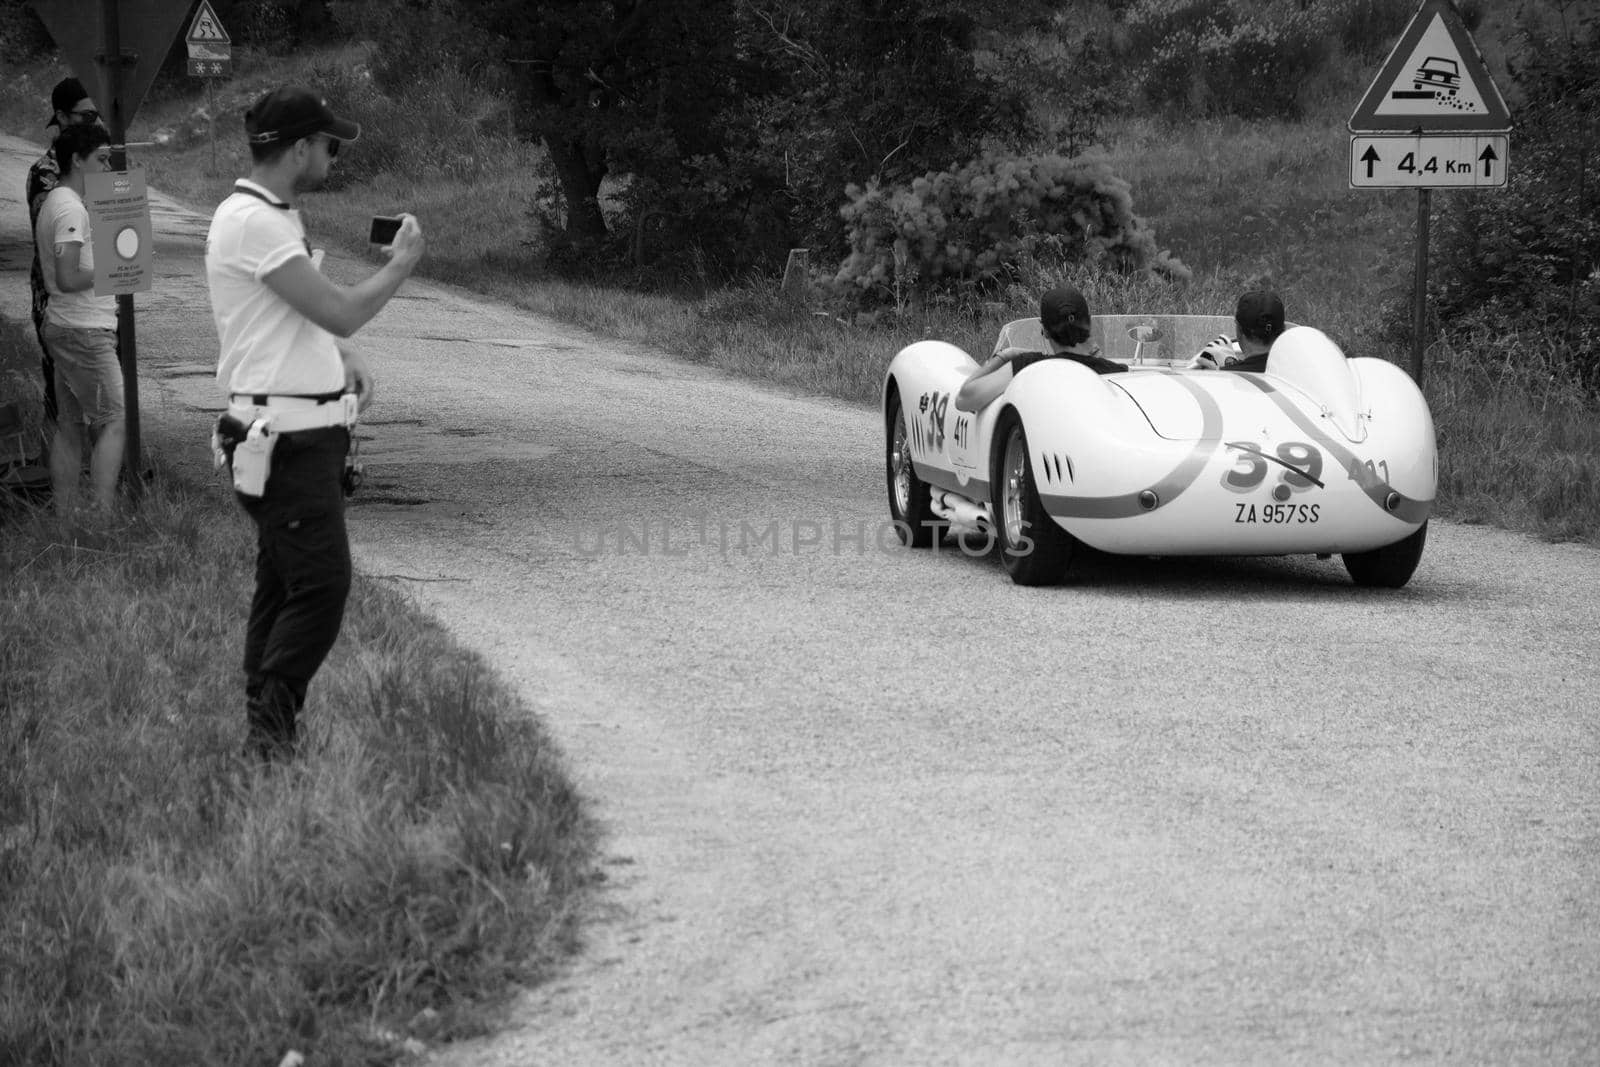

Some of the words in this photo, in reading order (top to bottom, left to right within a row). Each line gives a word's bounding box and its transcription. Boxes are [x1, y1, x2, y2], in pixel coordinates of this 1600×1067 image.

[1397, 152, 1438, 176] 4,4
[1446, 160, 1471, 173] Km
[954, 415, 968, 450] 411
[1220, 441, 1323, 493] 39
[1235, 503, 1257, 523] ZA
[1262, 504, 1320, 523] 957SS
